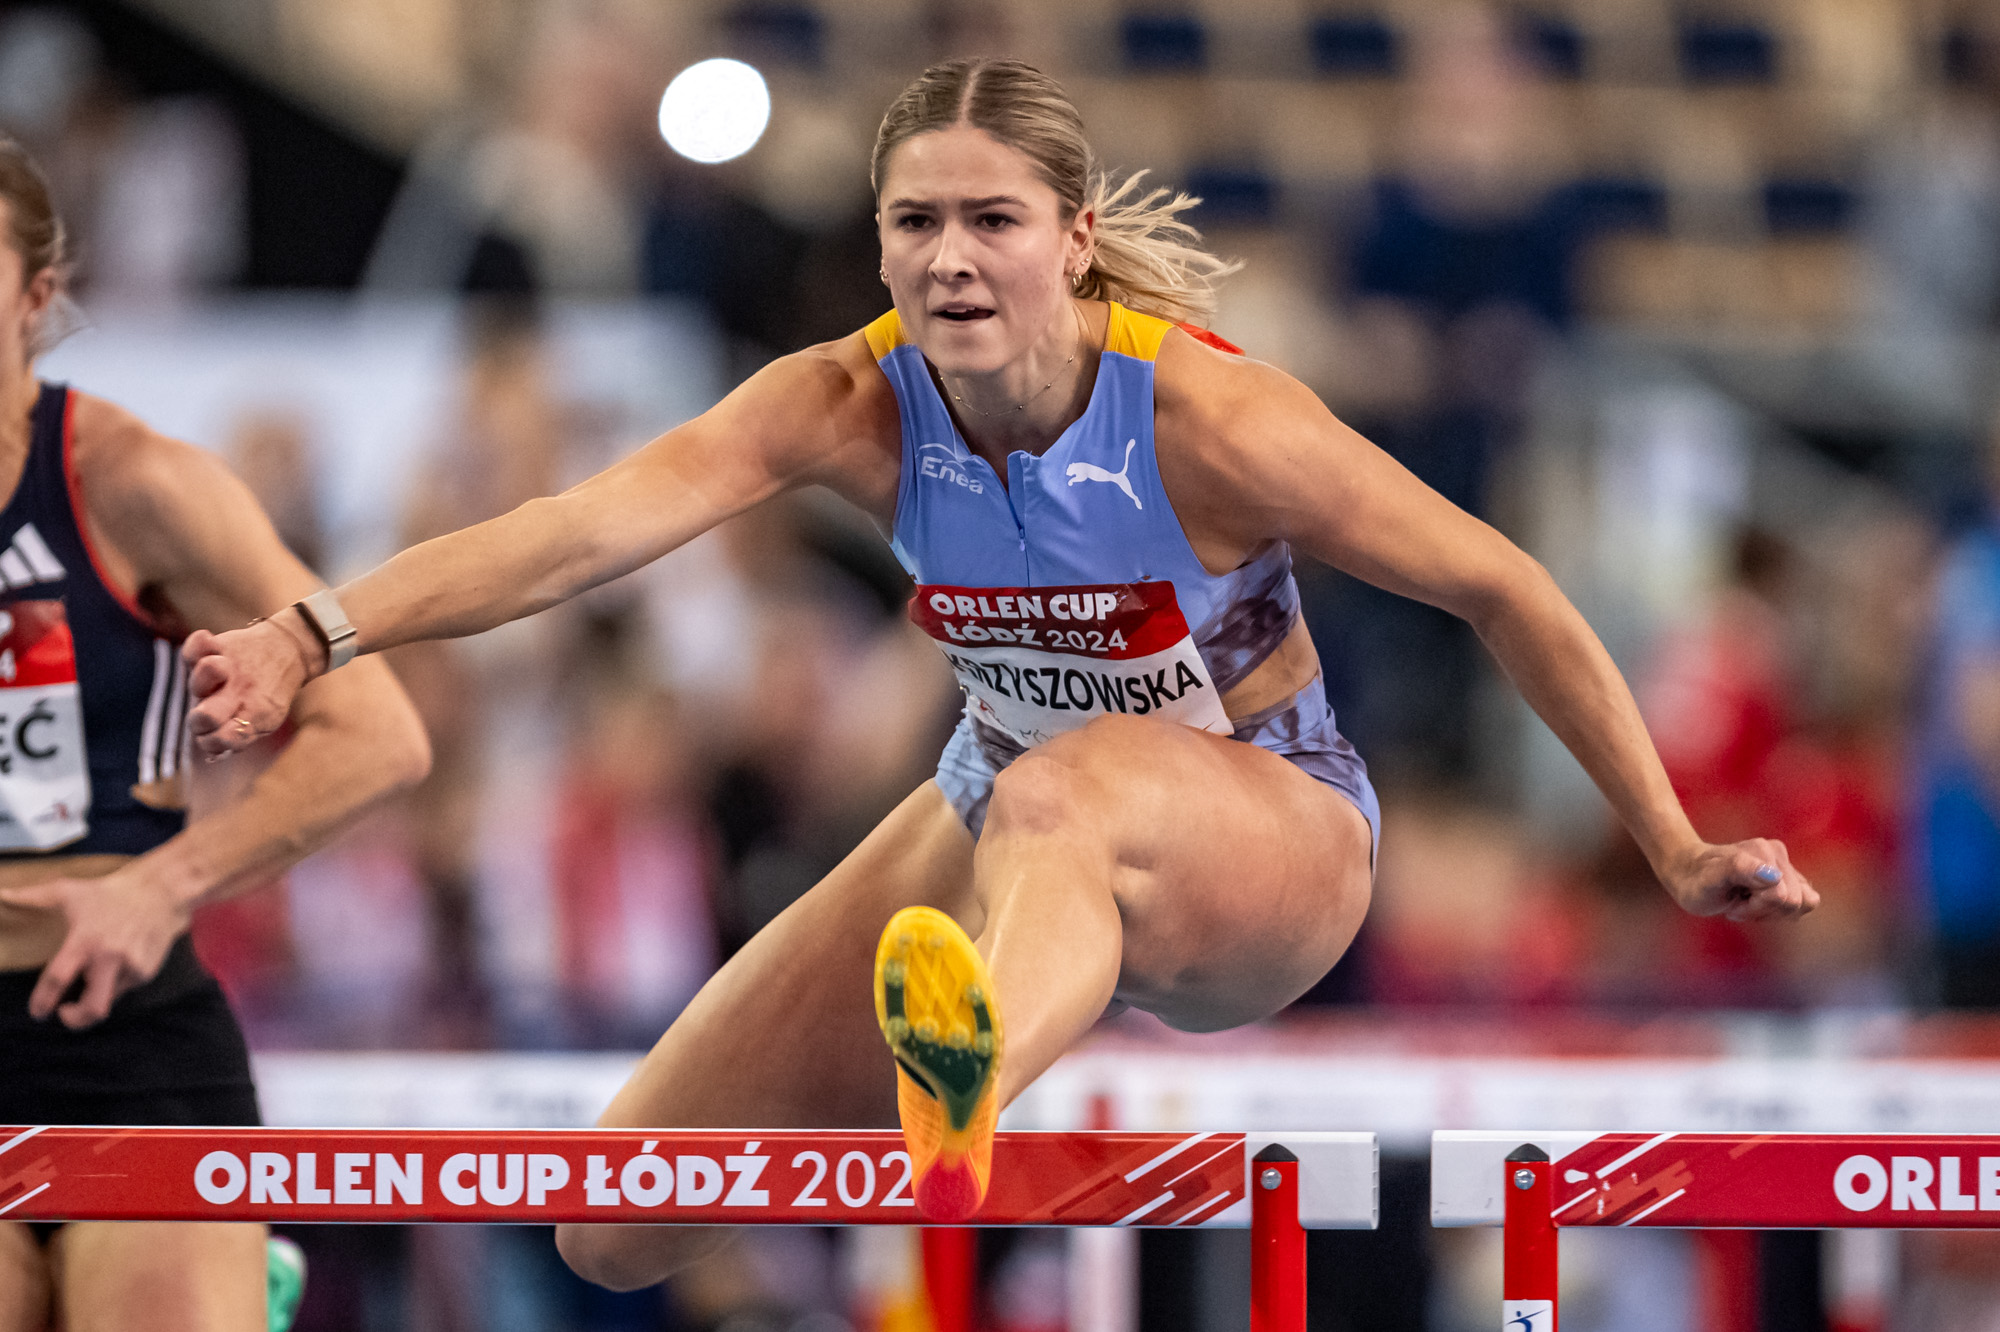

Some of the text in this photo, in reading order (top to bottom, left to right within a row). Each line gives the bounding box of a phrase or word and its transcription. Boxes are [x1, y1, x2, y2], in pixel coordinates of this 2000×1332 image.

[920, 455, 984, 495] Enea
[929, 592, 1118, 620] ORLEN CUP
[942, 621, 1129, 652] ŁÓDŹ 2024
[194, 1140, 916, 1208] ORLEN CUP ŁÓDŹ 202
[1832, 1154, 2000, 1211] ORLE
